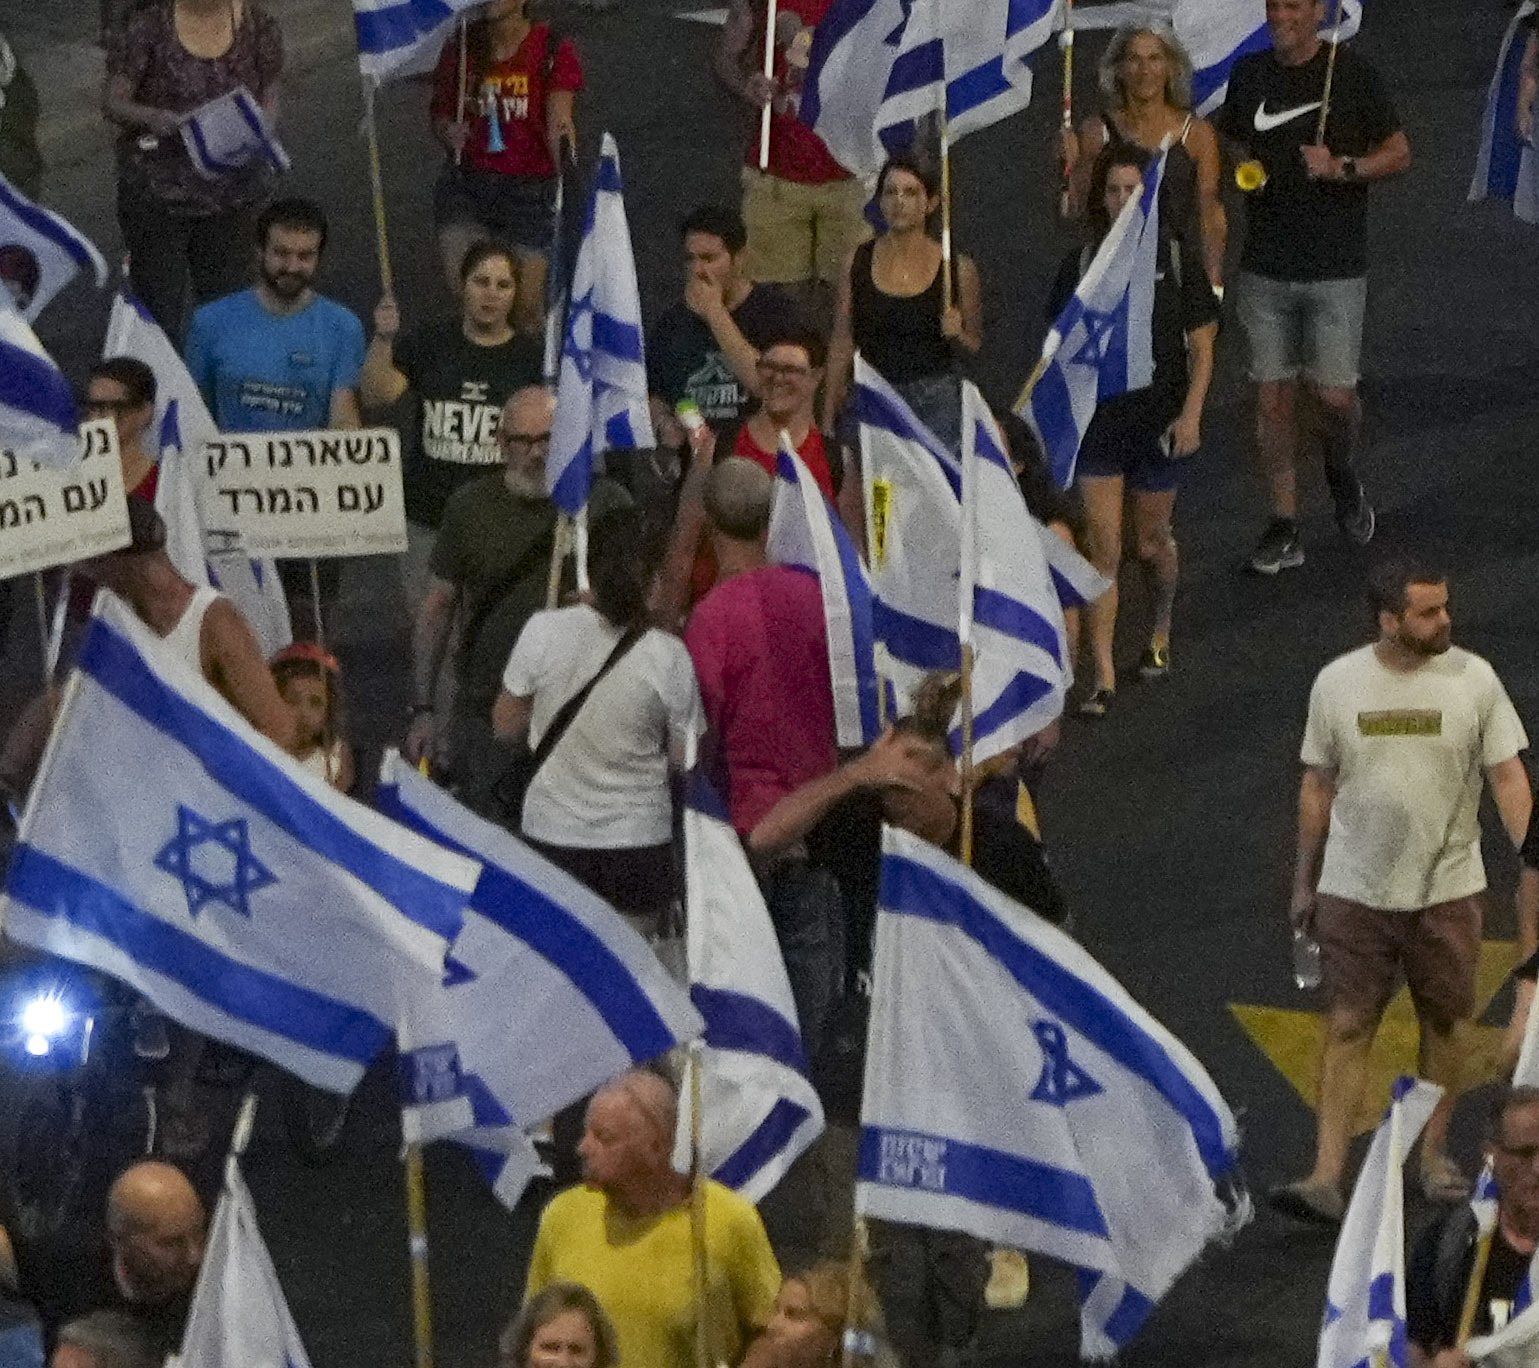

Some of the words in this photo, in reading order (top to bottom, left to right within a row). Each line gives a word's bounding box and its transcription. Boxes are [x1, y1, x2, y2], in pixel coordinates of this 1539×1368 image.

[422, 398, 503, 446] NEVE
[204, 442, 251, 477] רק
[267, 435, 393, 467] נשארנו
[62, 476, 109, 514] עם
[218, 483, 320, 515] המרד
[338, 482, 384, 515] עם
